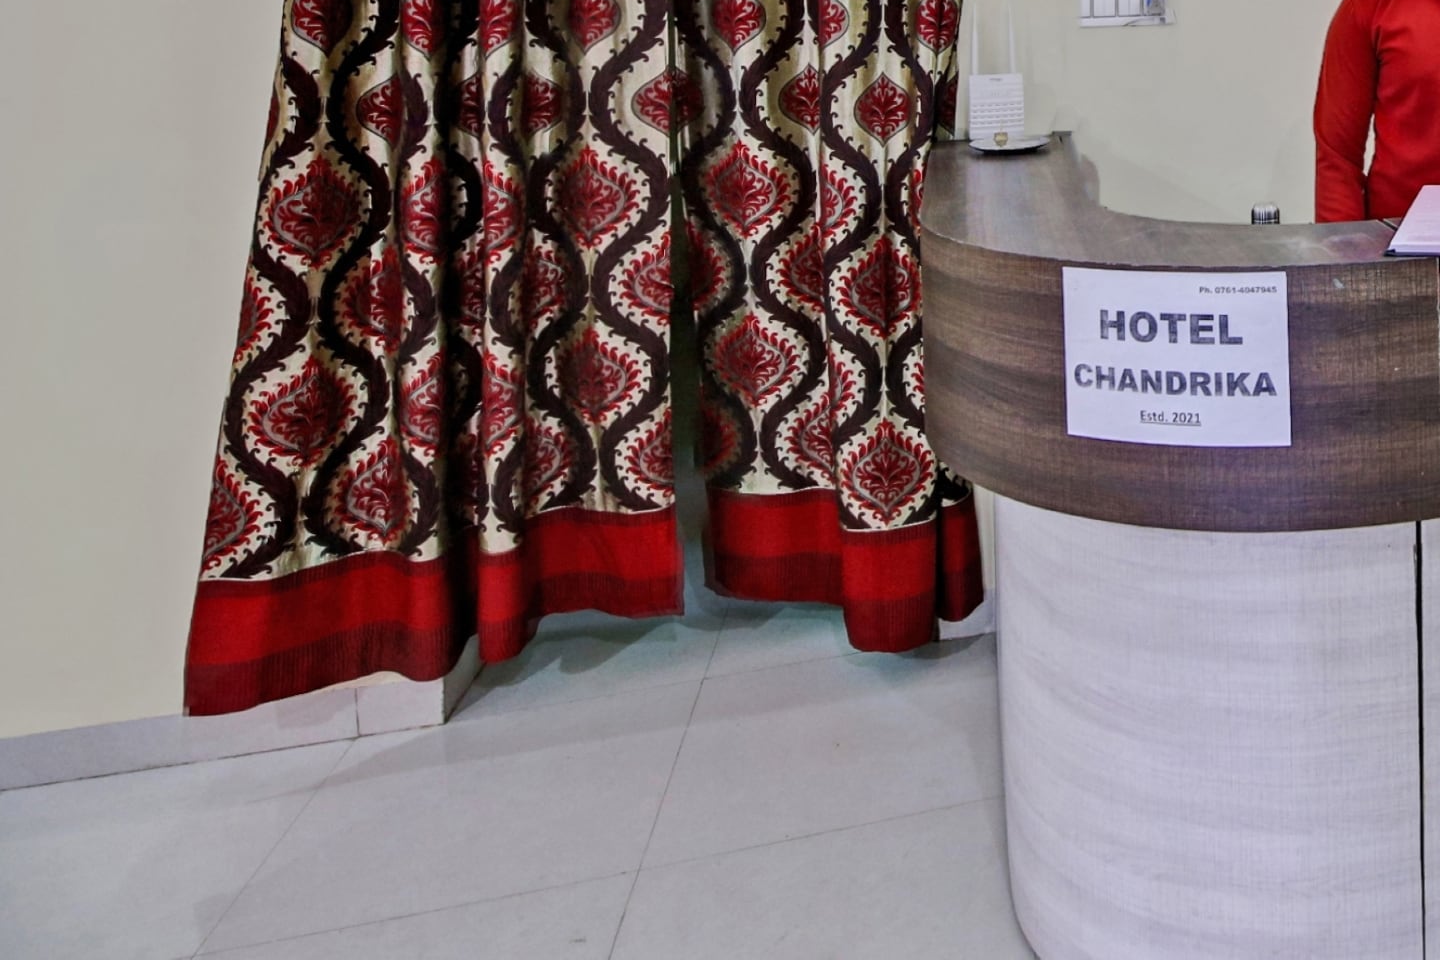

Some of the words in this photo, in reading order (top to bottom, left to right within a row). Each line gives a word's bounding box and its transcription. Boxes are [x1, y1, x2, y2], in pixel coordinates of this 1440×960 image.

[1099, 308, 1244, 346] HOTEL
[1073, 363, 1278, 398] CHANDRIKA
[1139, 410, 1169, 423] Estd.
[1172, 412, 1201, 424] 2021
